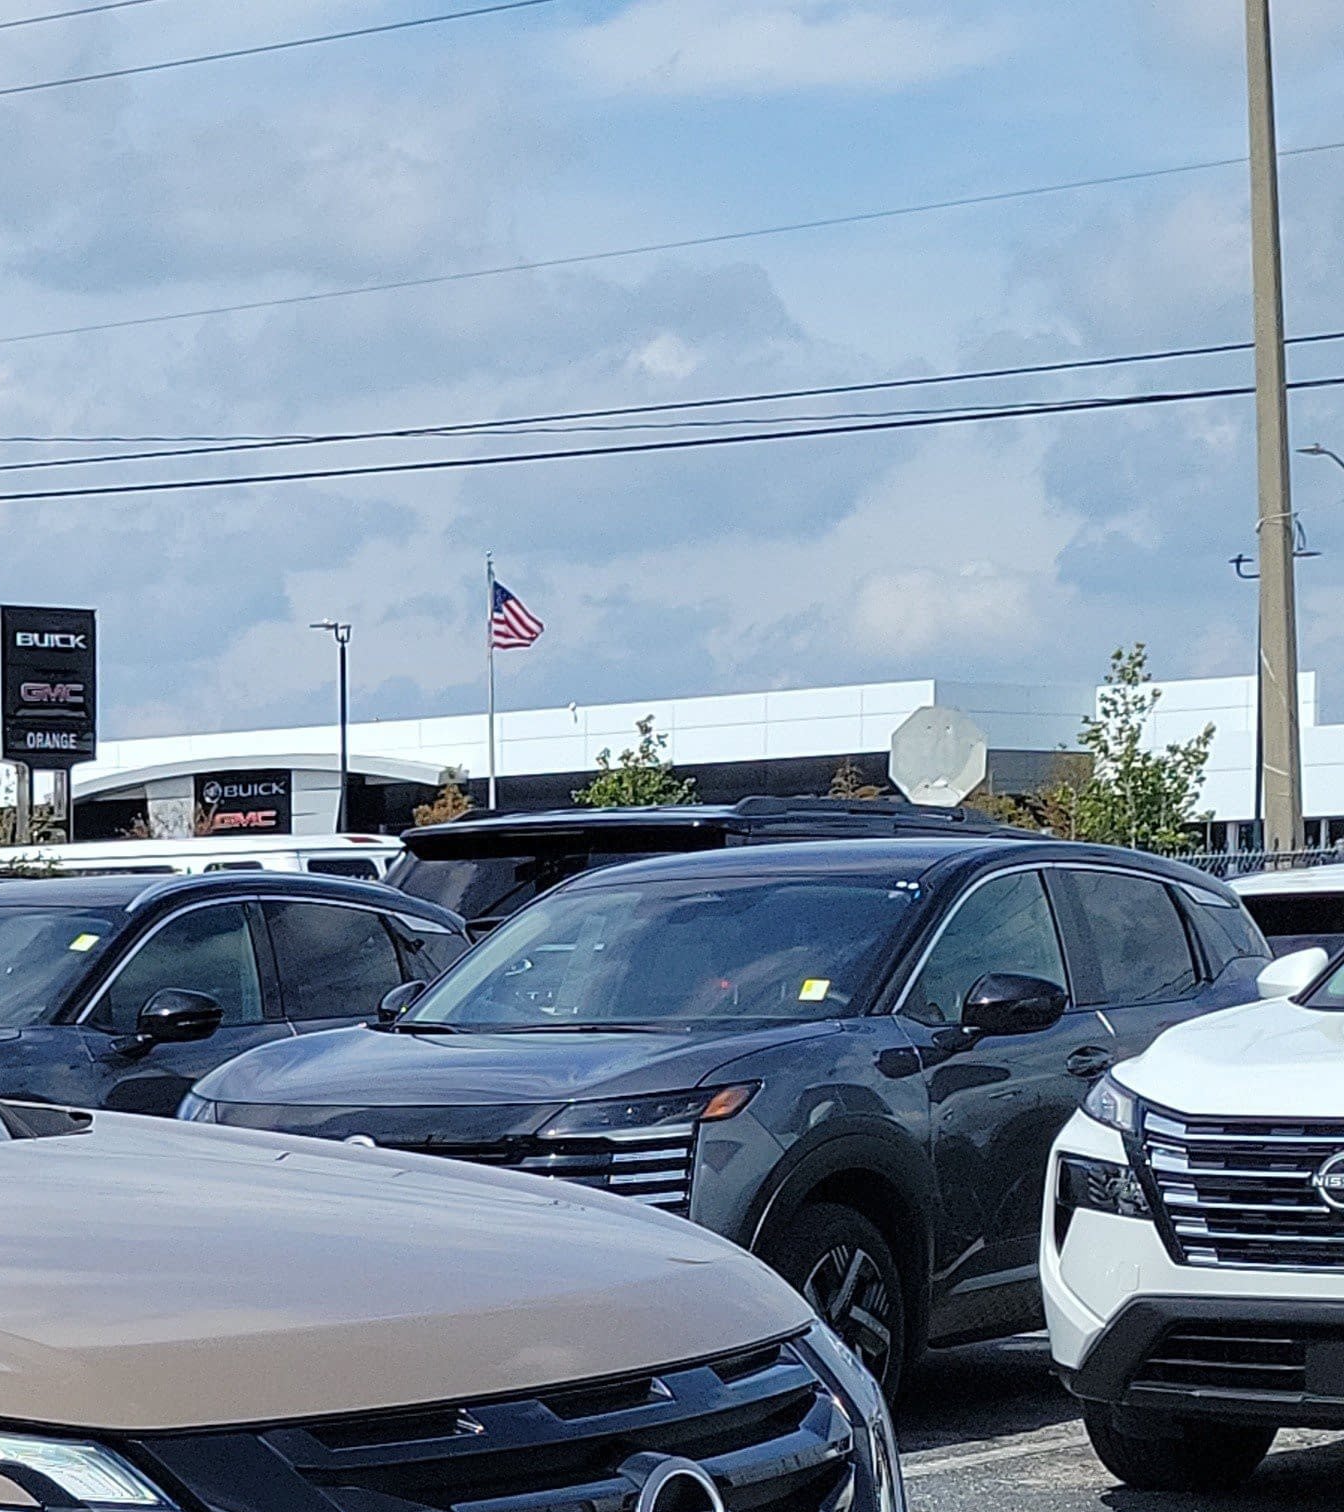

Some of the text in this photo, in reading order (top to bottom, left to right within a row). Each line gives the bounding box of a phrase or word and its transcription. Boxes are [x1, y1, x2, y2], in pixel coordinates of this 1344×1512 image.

[15, 631, 87, 649] BUICK
[20, 682, 85, 703] GMC
[26, 731, 78, 750] ORANGE
[223, 781, 287, 798] BUICK
[213, 810, 277, 830] GMC
